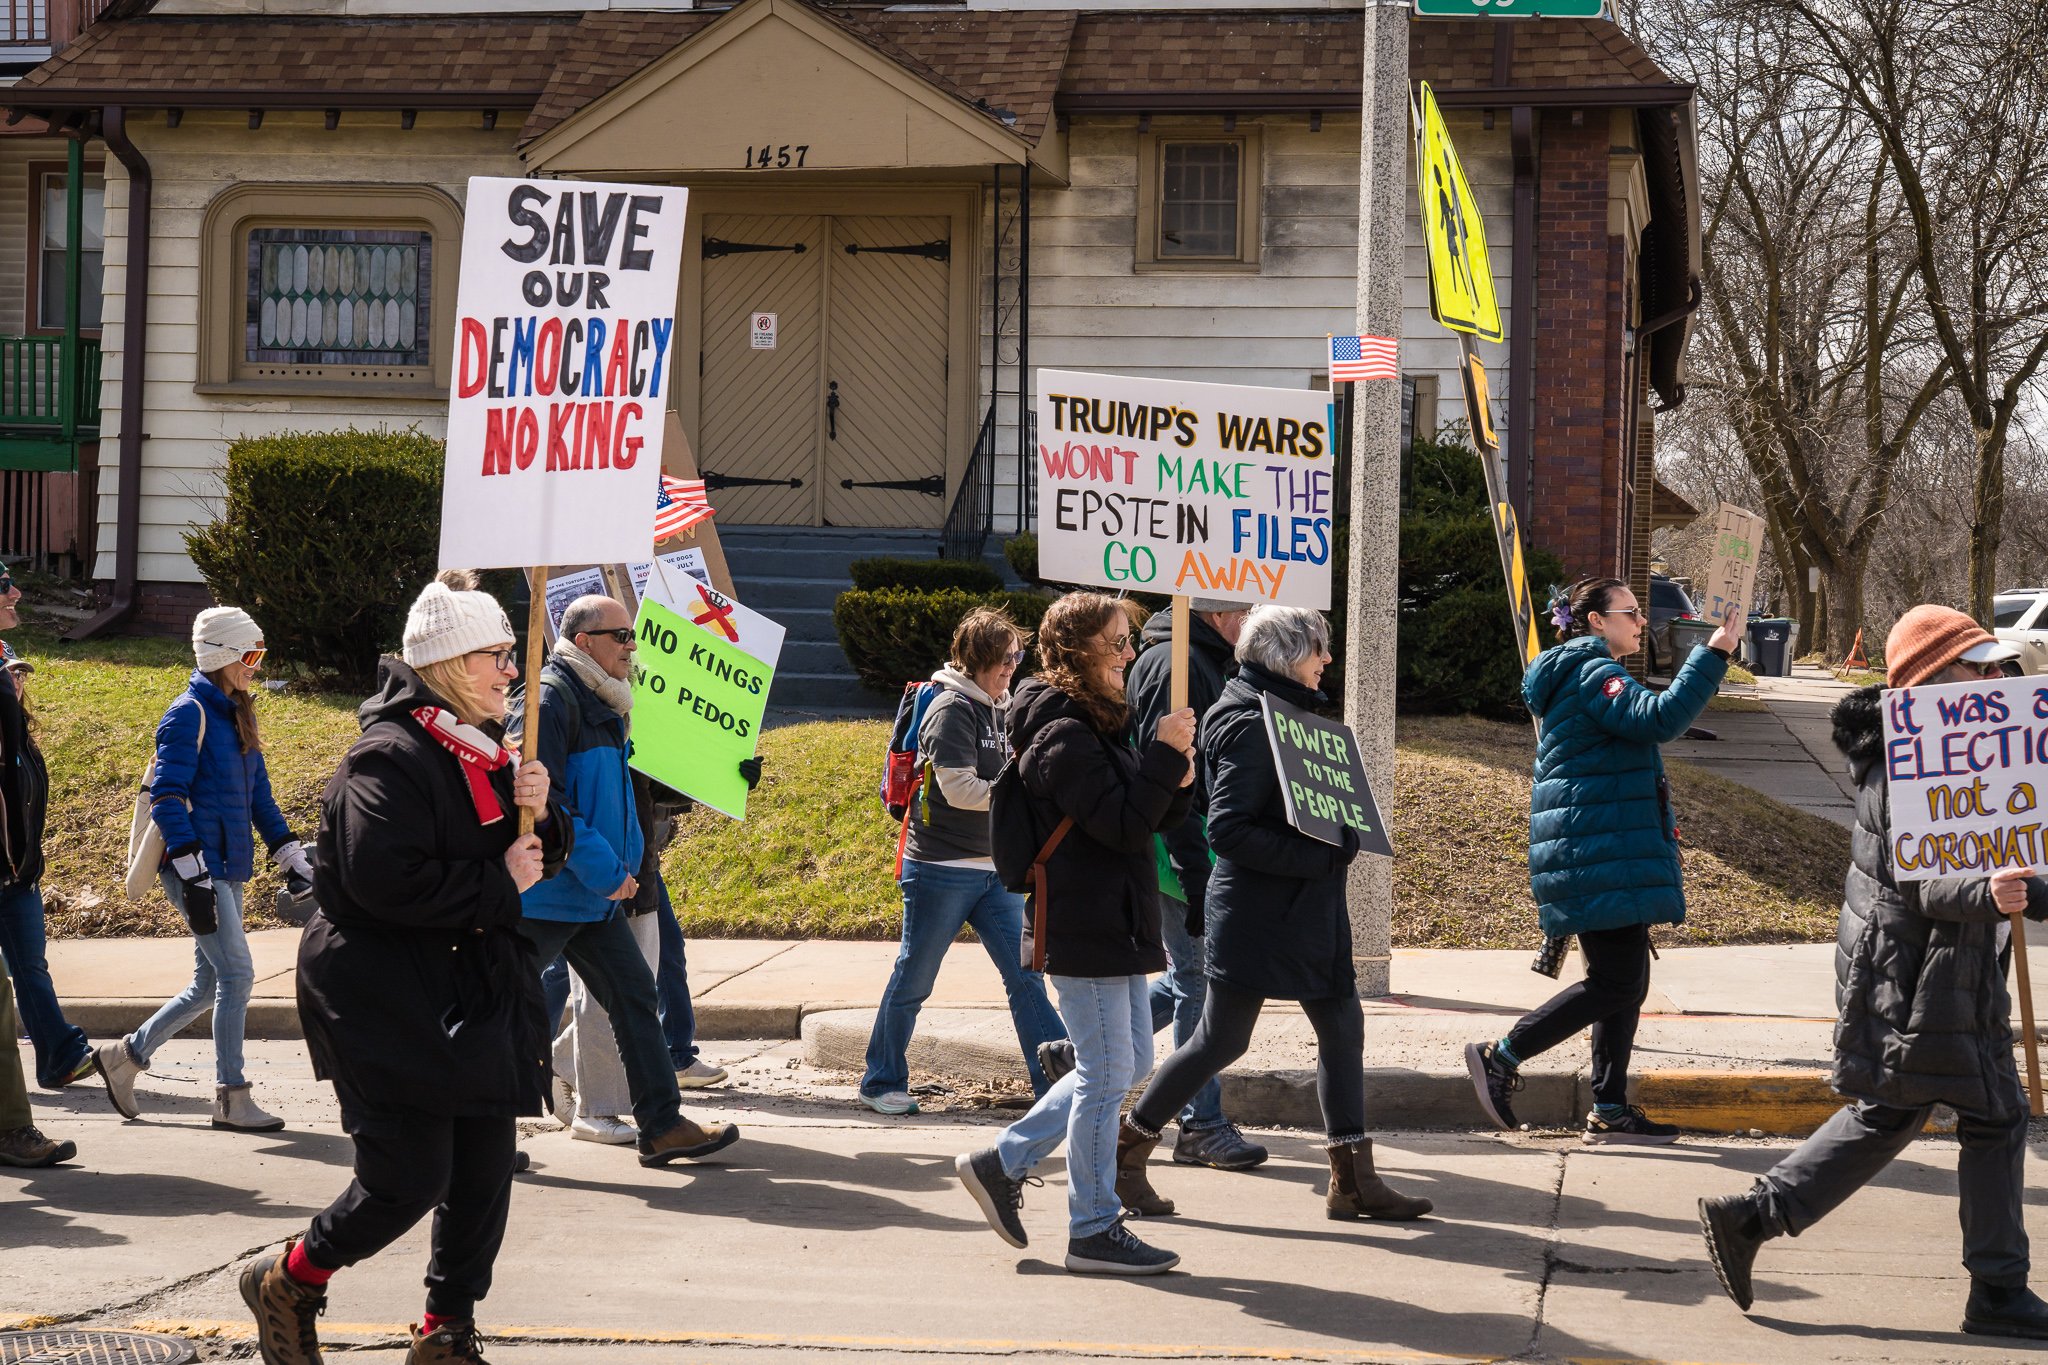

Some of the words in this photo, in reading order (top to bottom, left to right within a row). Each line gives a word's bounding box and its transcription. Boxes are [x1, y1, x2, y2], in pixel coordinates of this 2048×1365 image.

[745, 144, 809, 168] 1457
[500, 184, 664, 271] SAVE
[521, 270, 611, 309] OUR
[457, 316, 674, 399] DEMOCRACY
[481, 405, 539, 476] NO
[546, 401, 644, 472] KING
[1047, 392, 1200, 448] TRUMP'S
[1216, 411, 1326, 459] WARS
[1039, 440, 1140, 485] WON'T
[1158, 452, 1257, 500] MAKE
[1264, 465, 1333, 515] THE
[1055, 488, 1209, 545] EPSTEIN
[1231, 507, 1332, 566] FILES
[676, 553, 694, 562] DOGS
[676, 560, 695, 570] JULY
[1103, 540, 1158, 583] GO
[1174, 549, 1287, 600] AWAY
[1724, 580, 1743, 601] THE
[641, 617, 678, 655] NO
[689, 642, 764, 695] KINGS
[677, 686, 751, 738] PEDOS
[1936, 690, 2011, 728] was
[1274, 710, 1351, 766] POWER
[1302, 758, 1323, 782] TO
[1322, 765, 1356, 794] THE
[1926, 776, 1998, 823] not
[2006, 782, 2038, 815] a
[1290, 780, 1372, 833] PEOPLE
